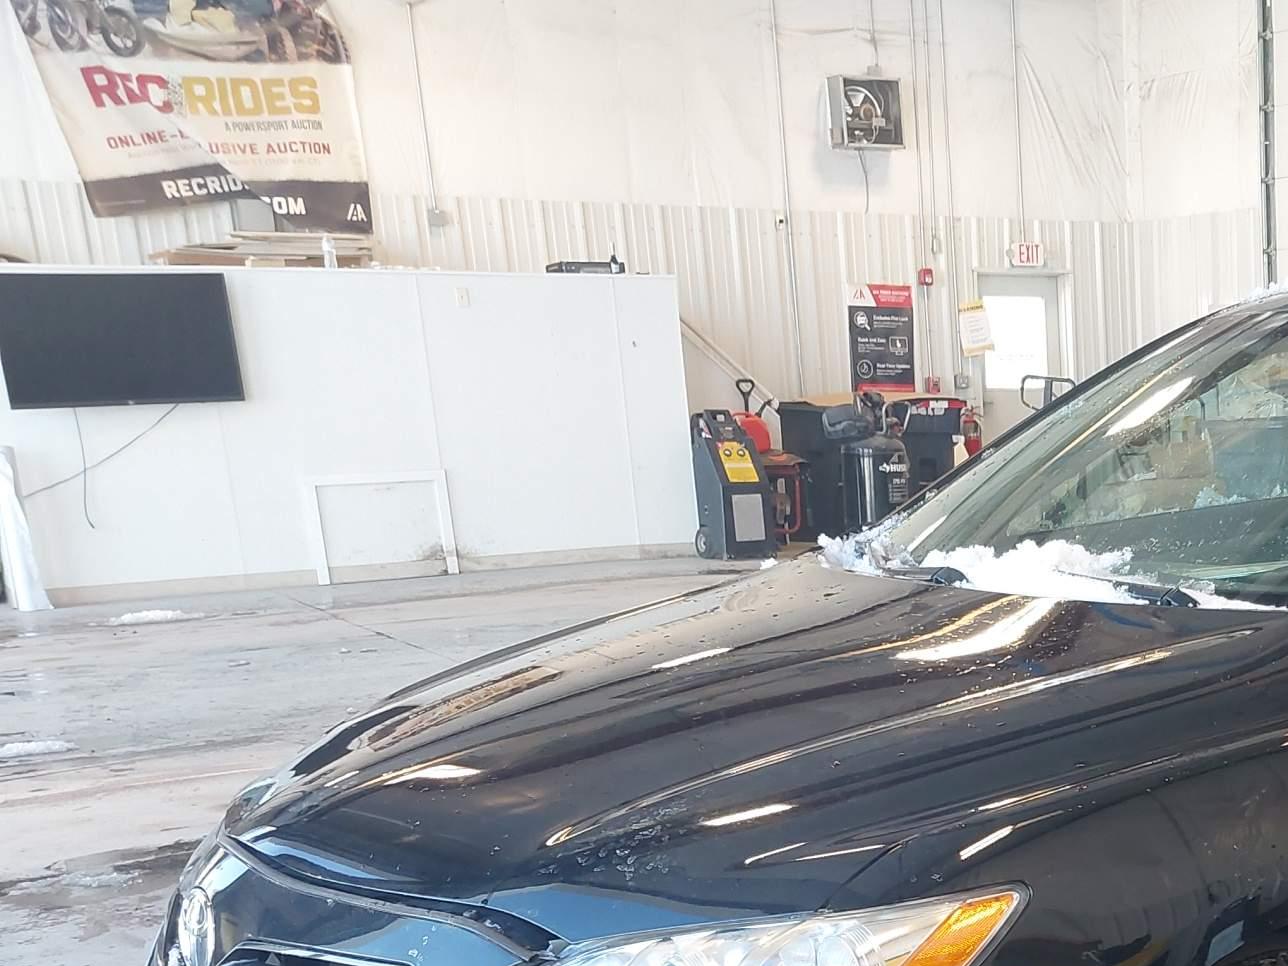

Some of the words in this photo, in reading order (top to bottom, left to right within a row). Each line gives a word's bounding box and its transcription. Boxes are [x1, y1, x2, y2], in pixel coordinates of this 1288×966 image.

[182, 76, 321, 117] RIDES
[232, 121, 289, 132] POWERSPORT
[291, 119, 323, 131] AUCTION
[266, 141, 332, 155] AUCTION
[1019, 244, 1039, 264] EXIT
